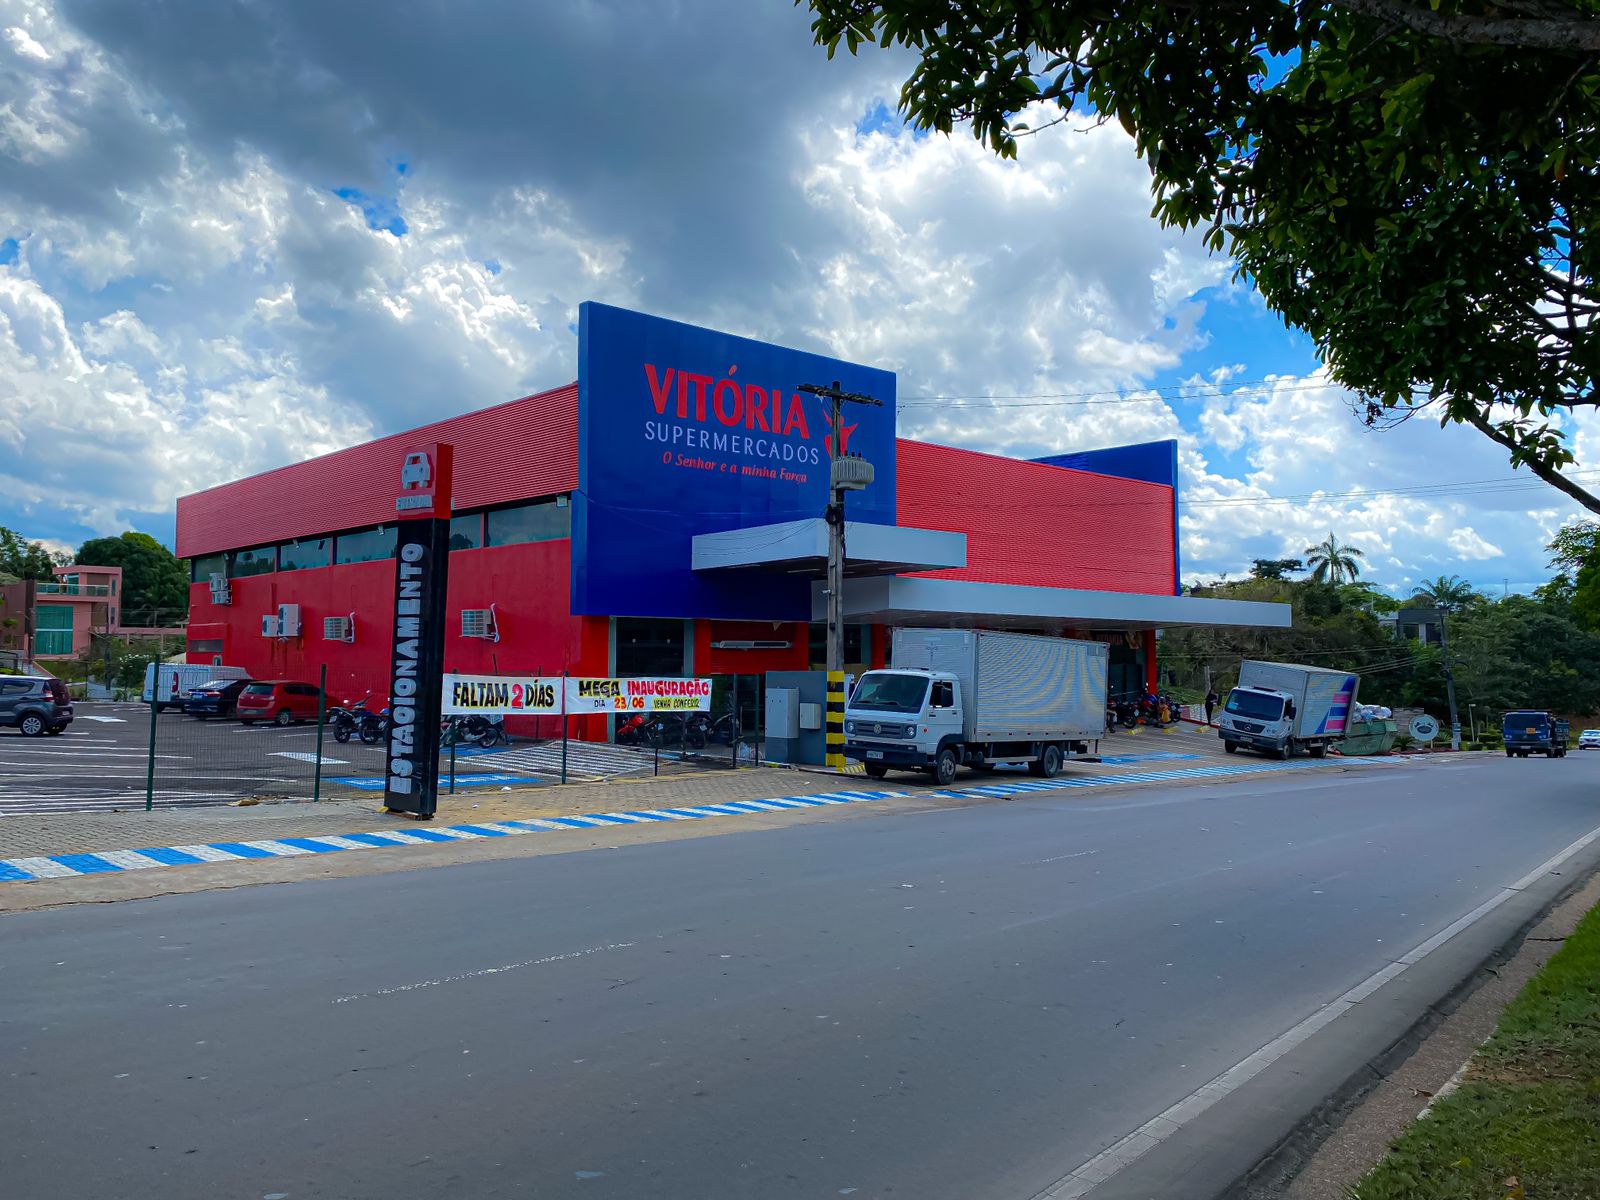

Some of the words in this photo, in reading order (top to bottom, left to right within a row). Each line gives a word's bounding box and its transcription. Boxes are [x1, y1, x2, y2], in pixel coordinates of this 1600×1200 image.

[644, 364, 810, 439] VITÓRIA
[645, 421, 820, 465] SUPERMERCADOS
[662, 451, 673, 464] O
[675, 453, 717, 470] Senhor
[729, 462, 737, 473] a
[741, 463, 777, 479] minha
[779, 467, 808, 484] Força
[390, 543, 424, 795] ESTACIONAMENTO
[452, 681, 509, 708] FALTAM
[511, 683, 525, 709] 2
[578, 680, 621, 697] MEGA
[627, 677, 710, 697] INAUGURAÇÃO
[614, 696, 645, 709] 23/06
[653, 699, 673, 709] VENHA
